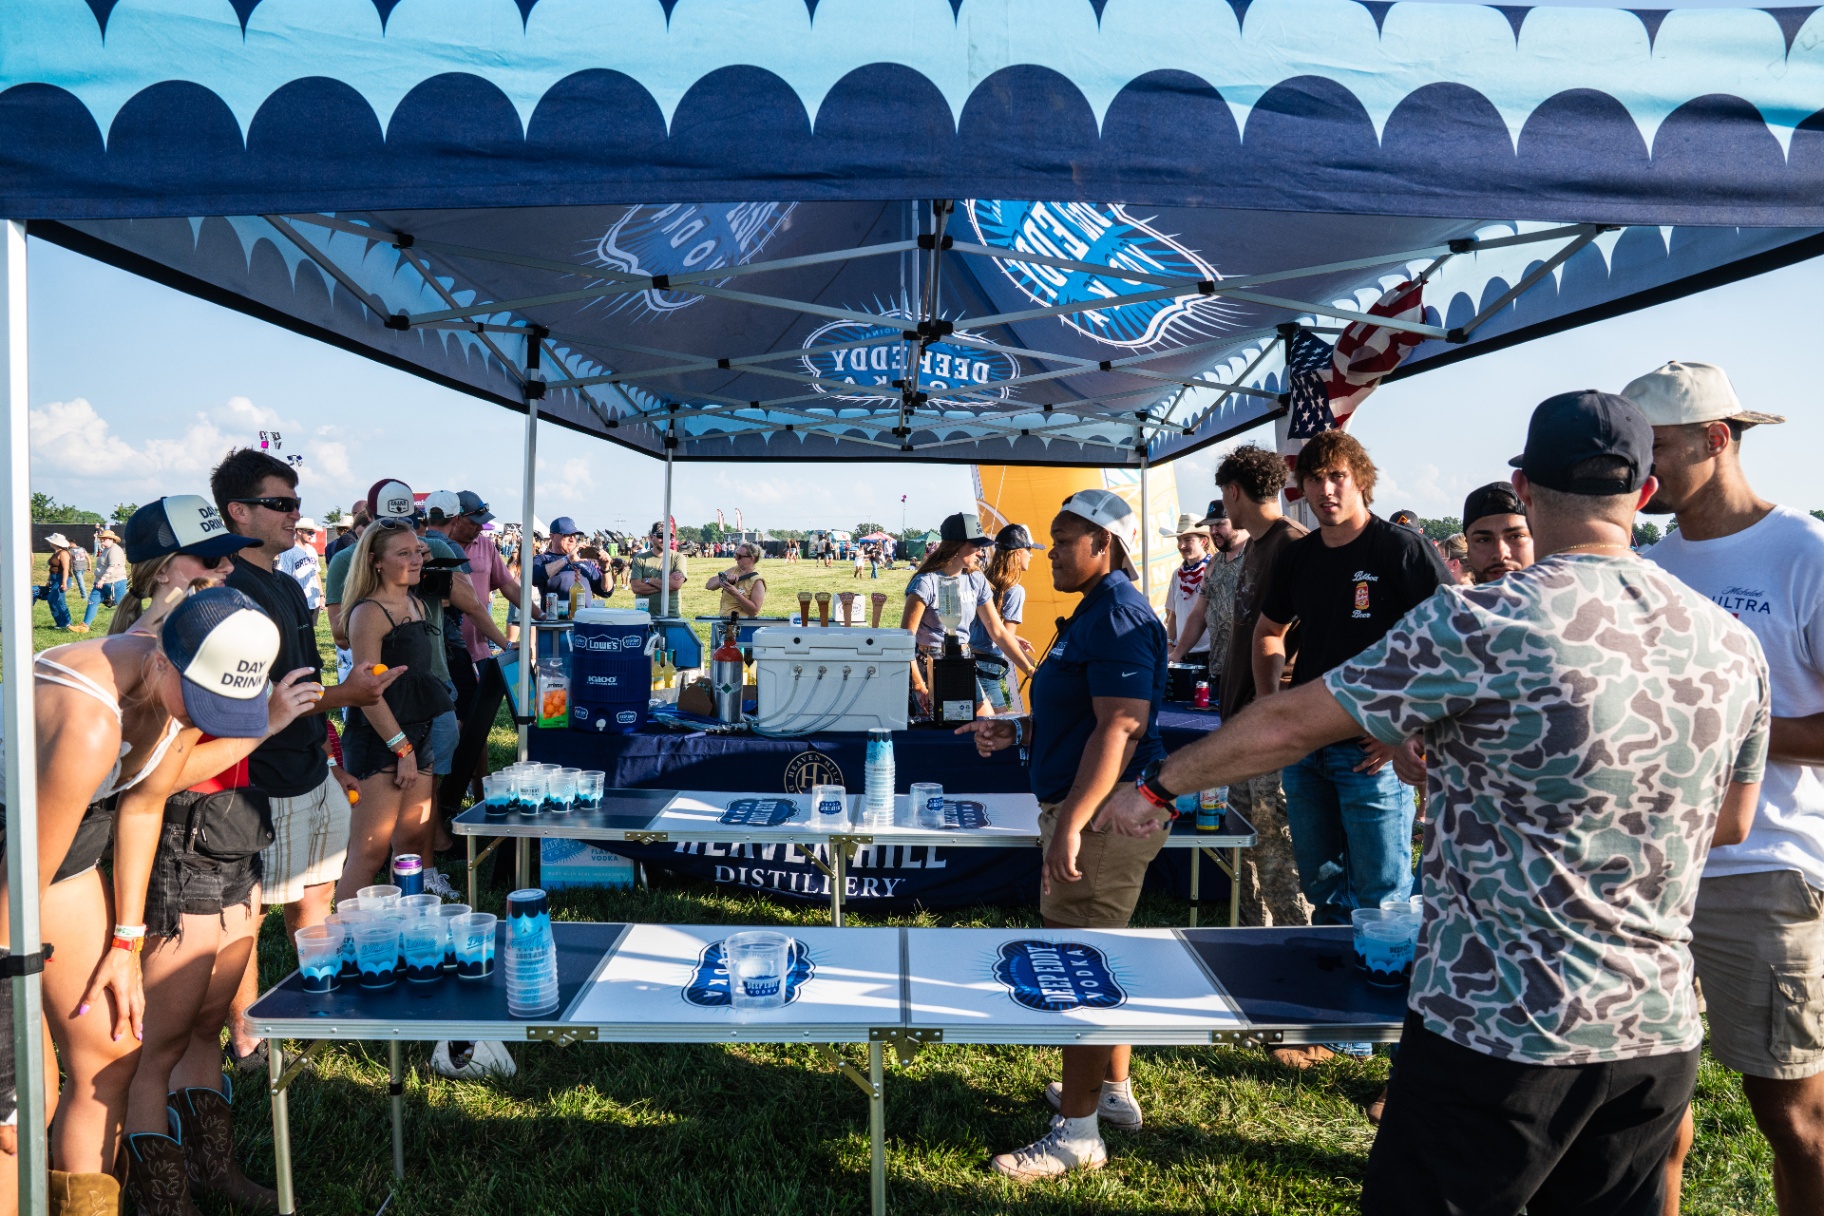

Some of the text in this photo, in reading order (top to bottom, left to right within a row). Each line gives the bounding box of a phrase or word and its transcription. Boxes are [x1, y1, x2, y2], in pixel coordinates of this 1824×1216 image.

[1721, 586, 1765, 597] Michelob
[589, 640, 619, 650] LOWE'S
[236, 659, 267, 675] DAY
[588, 675, 617, 683] IGLOO
[788, 754, 821, 778] HEAVEN
[703, 958, 737, 997] ODKA
[1027, 946, 1079, 1003] DEEP EDDY
[1066, 949, 1104, 999] VODKA
[747, 981, 763, 989] DEEP
[749, 987, 777, 995] VODKA
